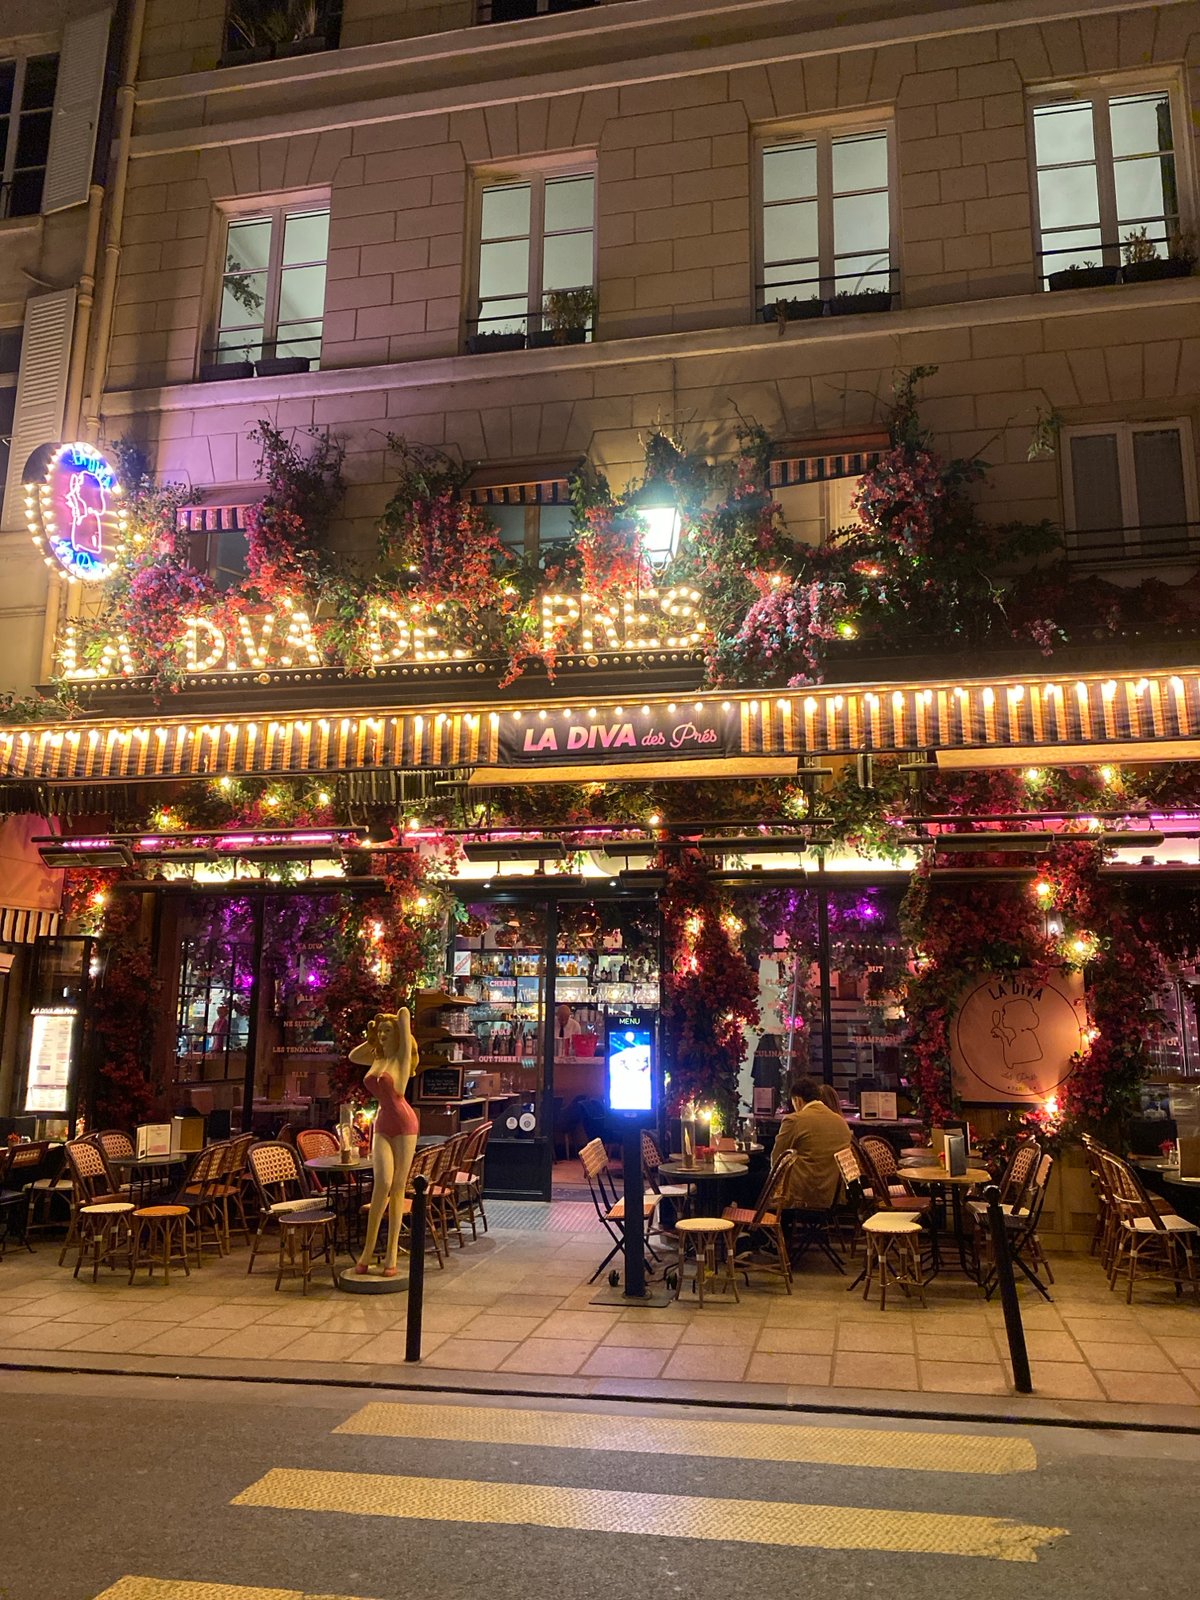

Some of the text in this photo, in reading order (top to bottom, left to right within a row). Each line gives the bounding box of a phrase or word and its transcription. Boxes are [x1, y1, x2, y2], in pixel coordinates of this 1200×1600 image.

[63, 626, 134, 678] LA
[523, 722, 717, 752] LA DIVA des Prés
[867, 965, 884, 973] BUT
[988, 982, 1043, 1001] LA DIVA
[619, 1017, 641, 1025] MENU
[479, 1056, 493, 1064] OUT
